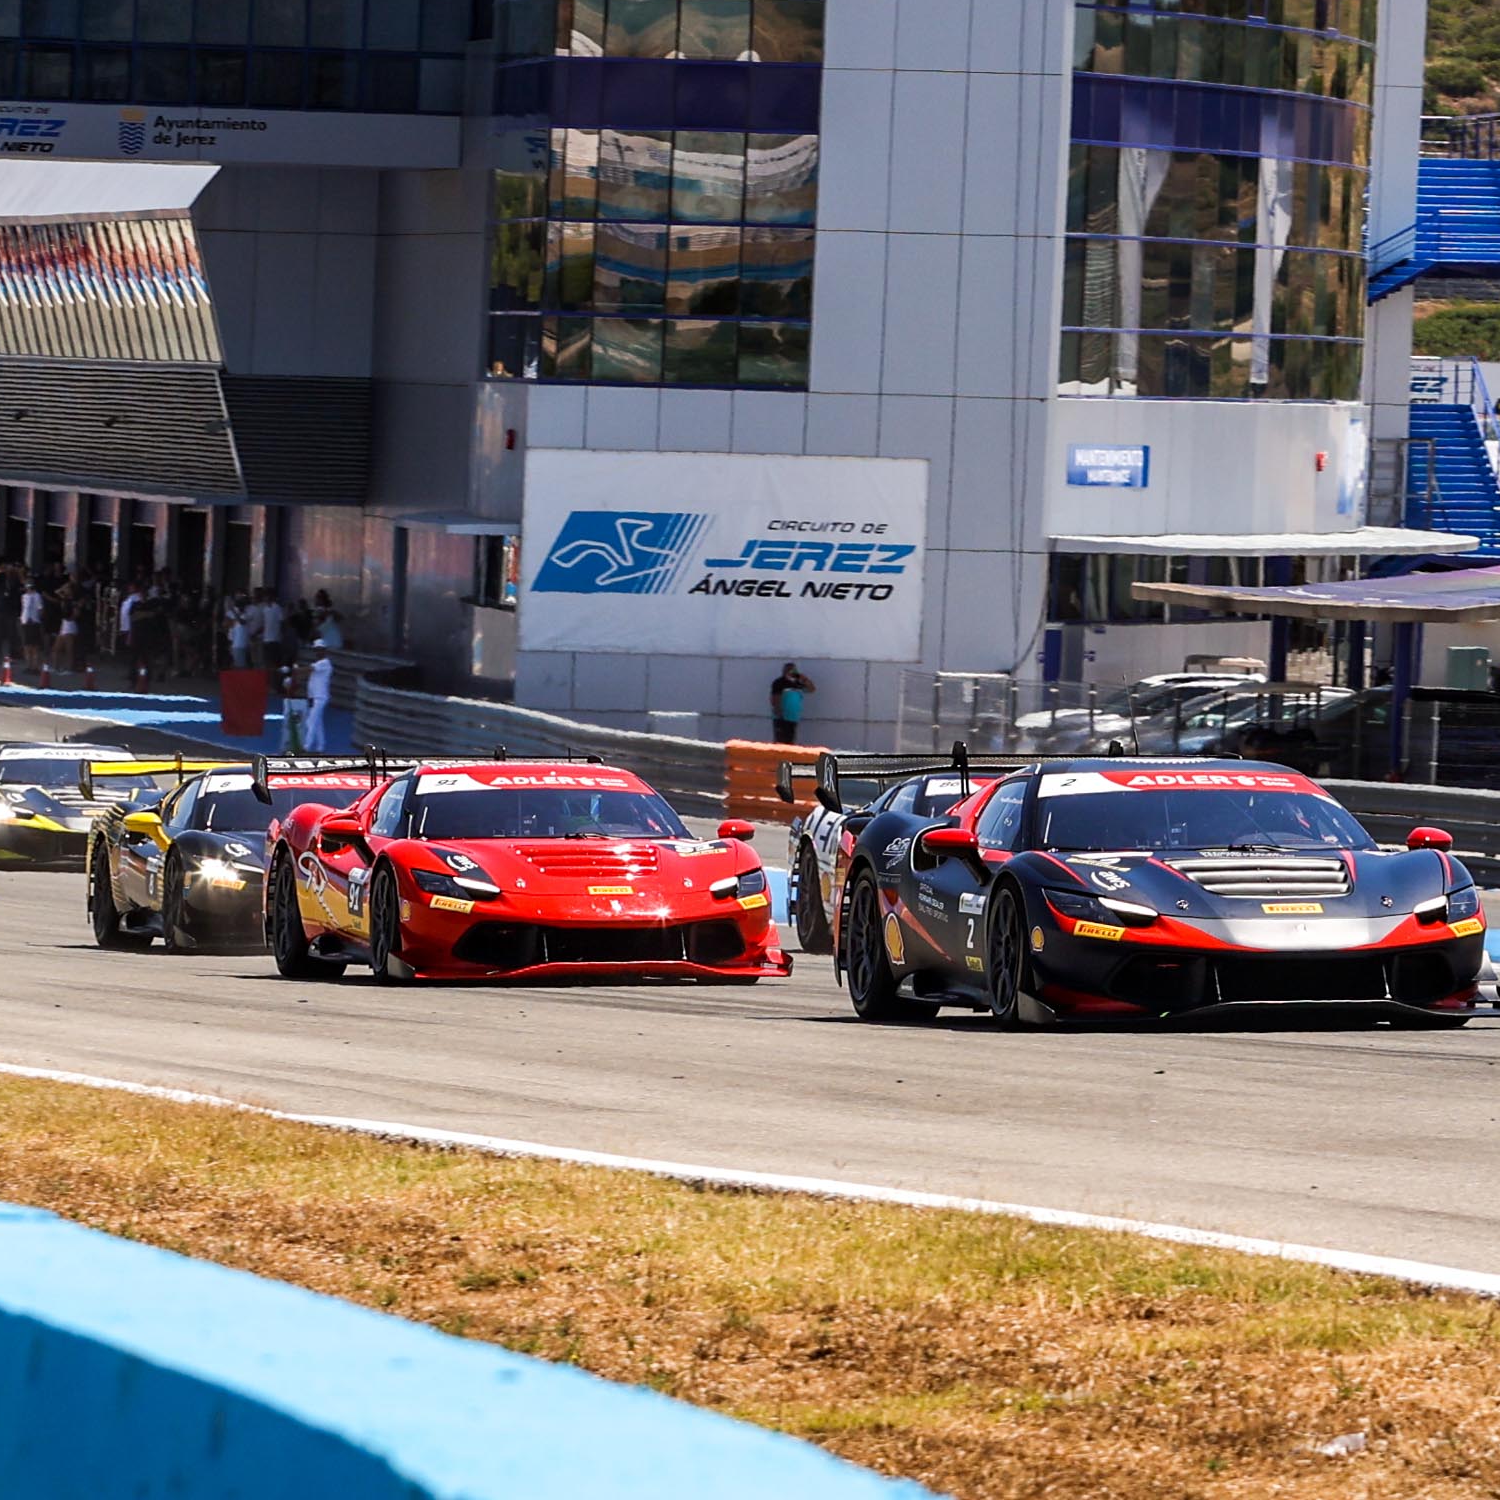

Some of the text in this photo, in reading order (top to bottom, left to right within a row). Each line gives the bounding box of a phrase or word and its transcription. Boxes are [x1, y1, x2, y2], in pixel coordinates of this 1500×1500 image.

[35, 106, 51, 114] DE
[153, 115, 267, 132] Ayuntamiento
[1, 141, 54, 153] NIETO
[153, 132, 217, 147] de Jerez
[767, 519, 888, 534] CIRCUITO DE
[704, 539, 916, 574] JEREZ
[688, 573, 893, 601] ÁNGEL NIETO
[269, 776, 341, 786] ADLER
[436, 776, 577, 786] 91 ADLER
[1060, 775, 1235, 787] 2 ADLER
[1099, 870, 1131, 890] aws
[348, 883, 360, 911] 91
[435, 898, 470, 911] PIRELLI
[1267, 902, 1317, 913] PIRELLI
[966, 918, 976, 949] 2
[1078, 923, 1119, 938] PIRELLI
